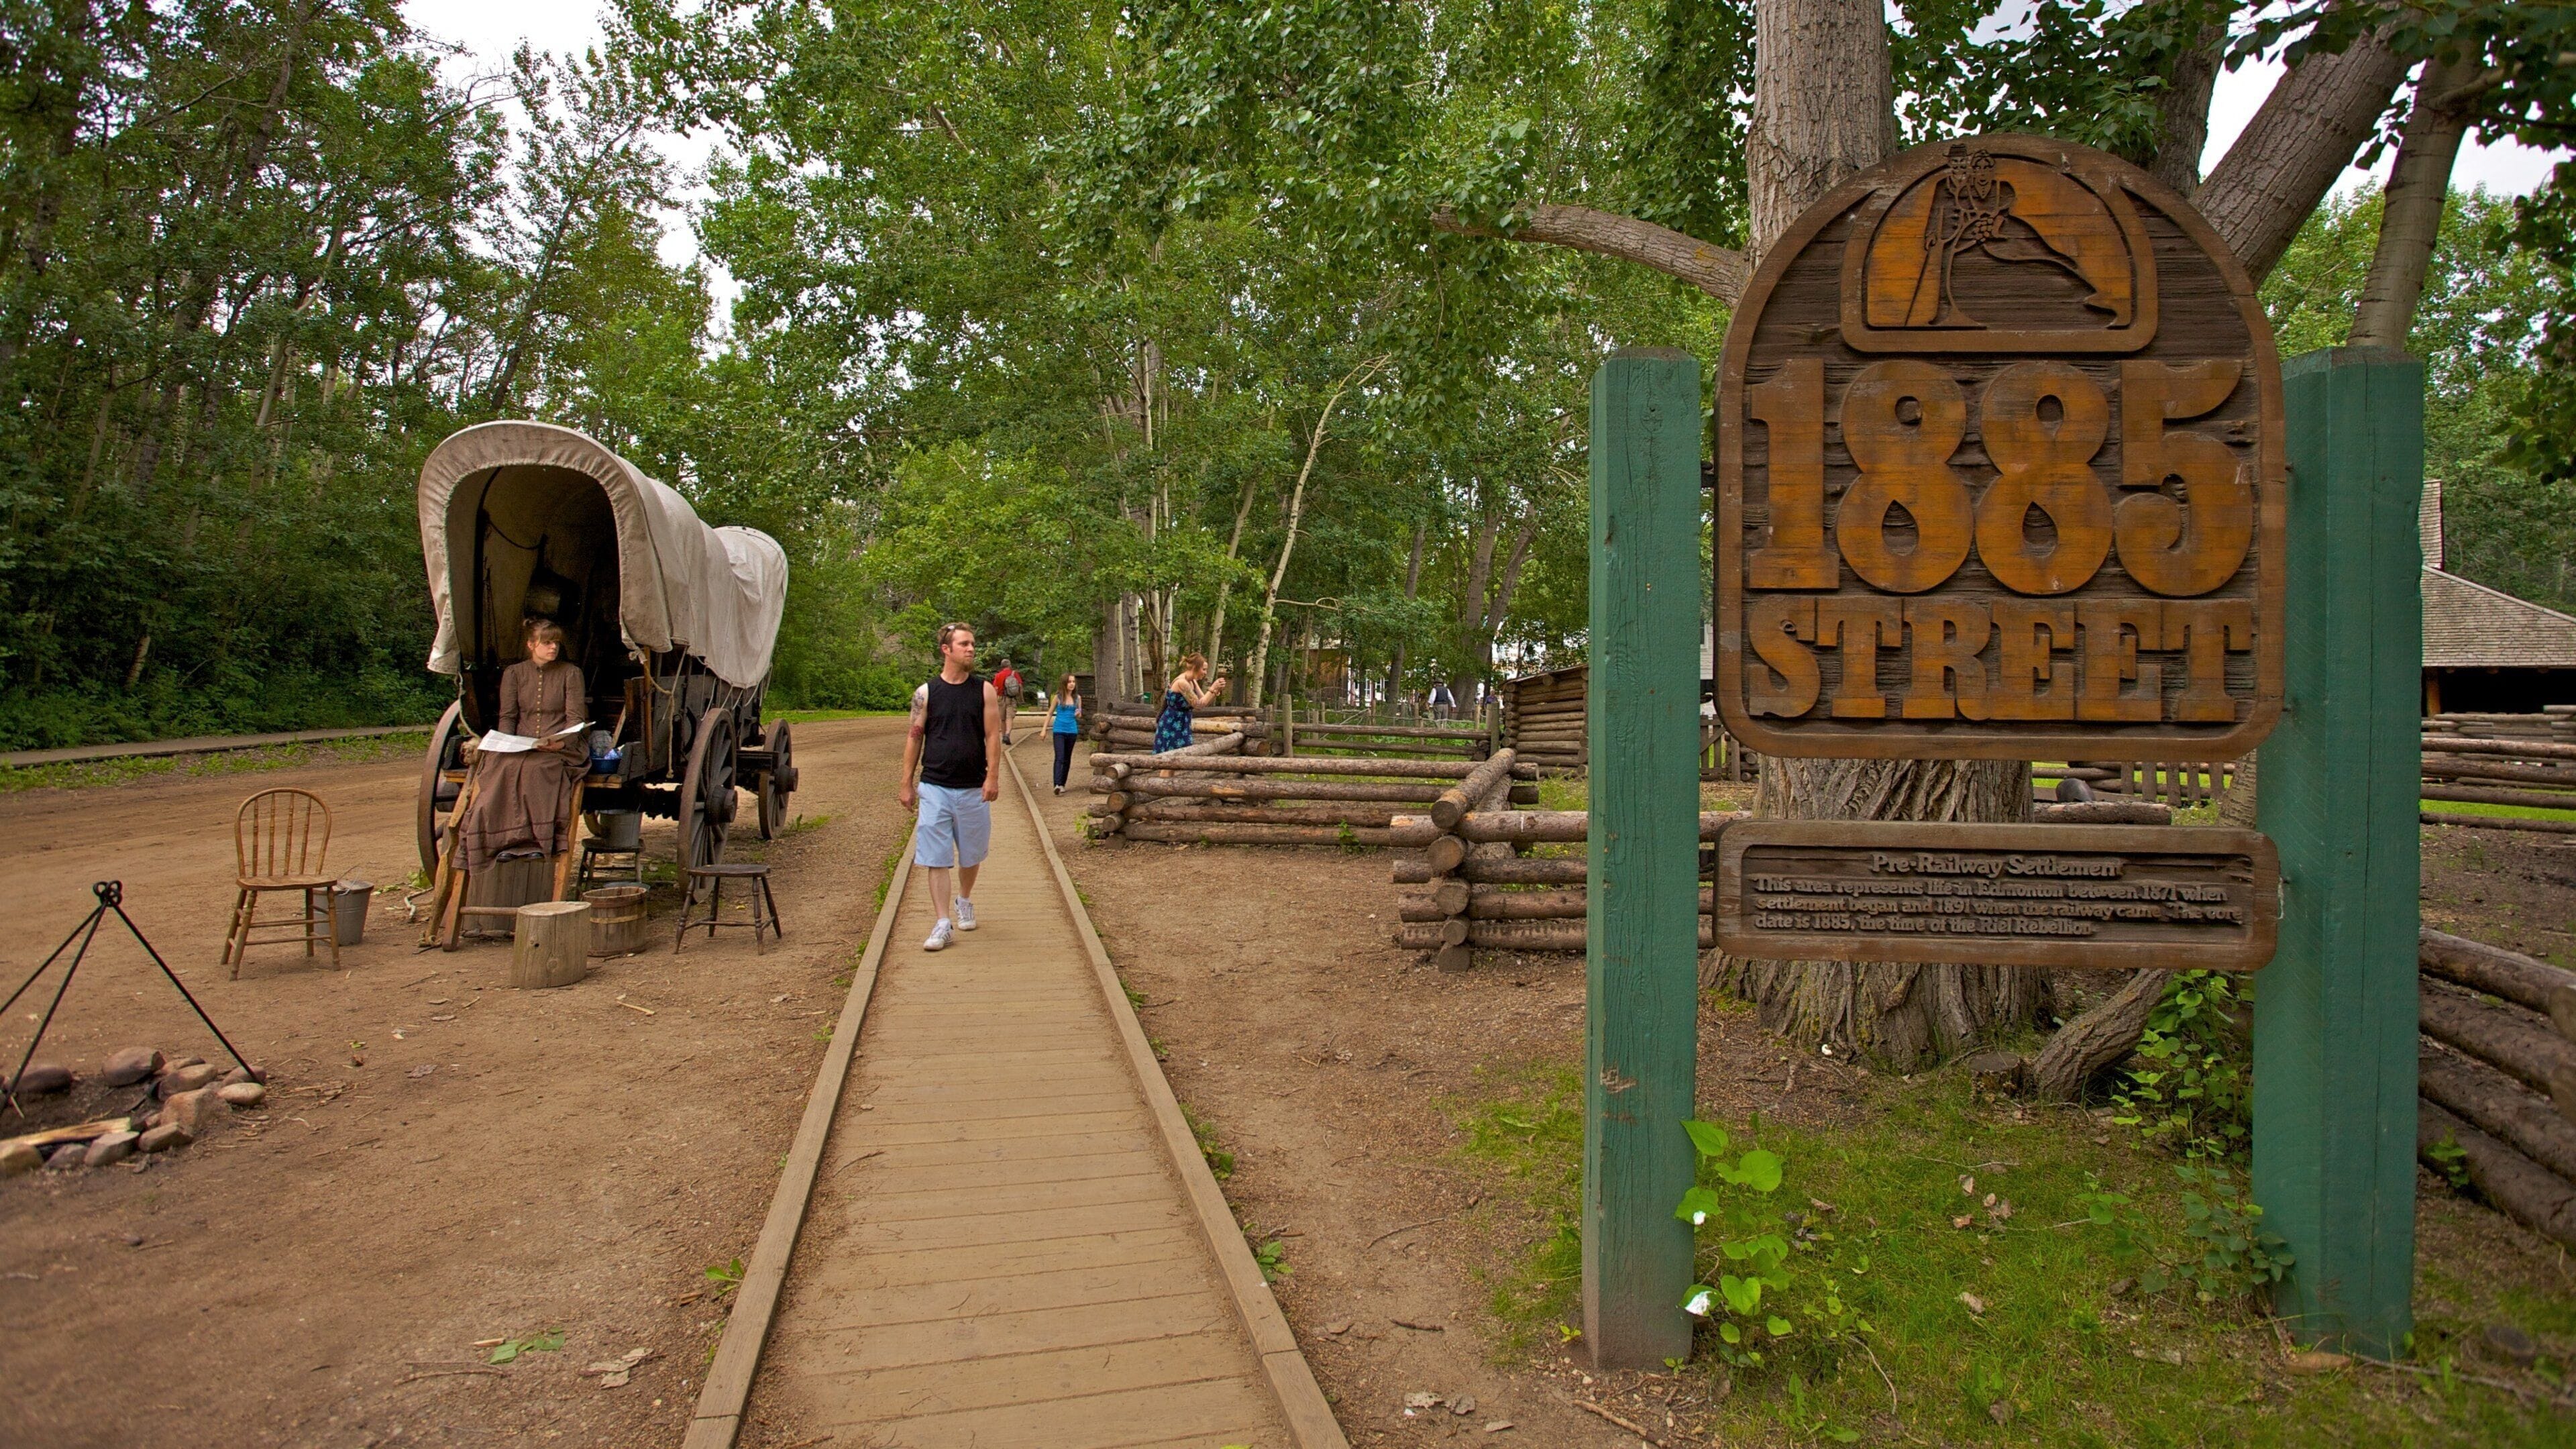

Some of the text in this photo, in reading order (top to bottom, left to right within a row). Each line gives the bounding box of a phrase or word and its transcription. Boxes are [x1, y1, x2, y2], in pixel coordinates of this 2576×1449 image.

[1749, 358, 2254, 596] 1885
[1748, 596, 2253, 722] STREET
[1754, 876, 2229, 902] This area represents life in Edmonton between 1871 when
[1756, 896, 1845, 912] settlement
[1847, 898, 1898, 915] began
[1901, 898, 1933, 914] and
[1936, 898, 1971, 914] 1891
[1973, 900, 2020, 915] when
[2021, 902, 2049, 916] the
[2050, 902, 2113, 921] railway
[2165, 902, 2203, 920] The
[2205, 906, 2243, 921] core
[1754, 912, 1793, 928] date
[1794, 914, 1811, 928] is
[1813, 913, 1856, 931] 1885,
[1856, 914, 1886, 930] the
[1886, 915, 1926, 931] time
[1929, 916, 1946, 932] of
[1946, 917, 1976, 932] the
[1978, 917, 2012, 933] Riel
